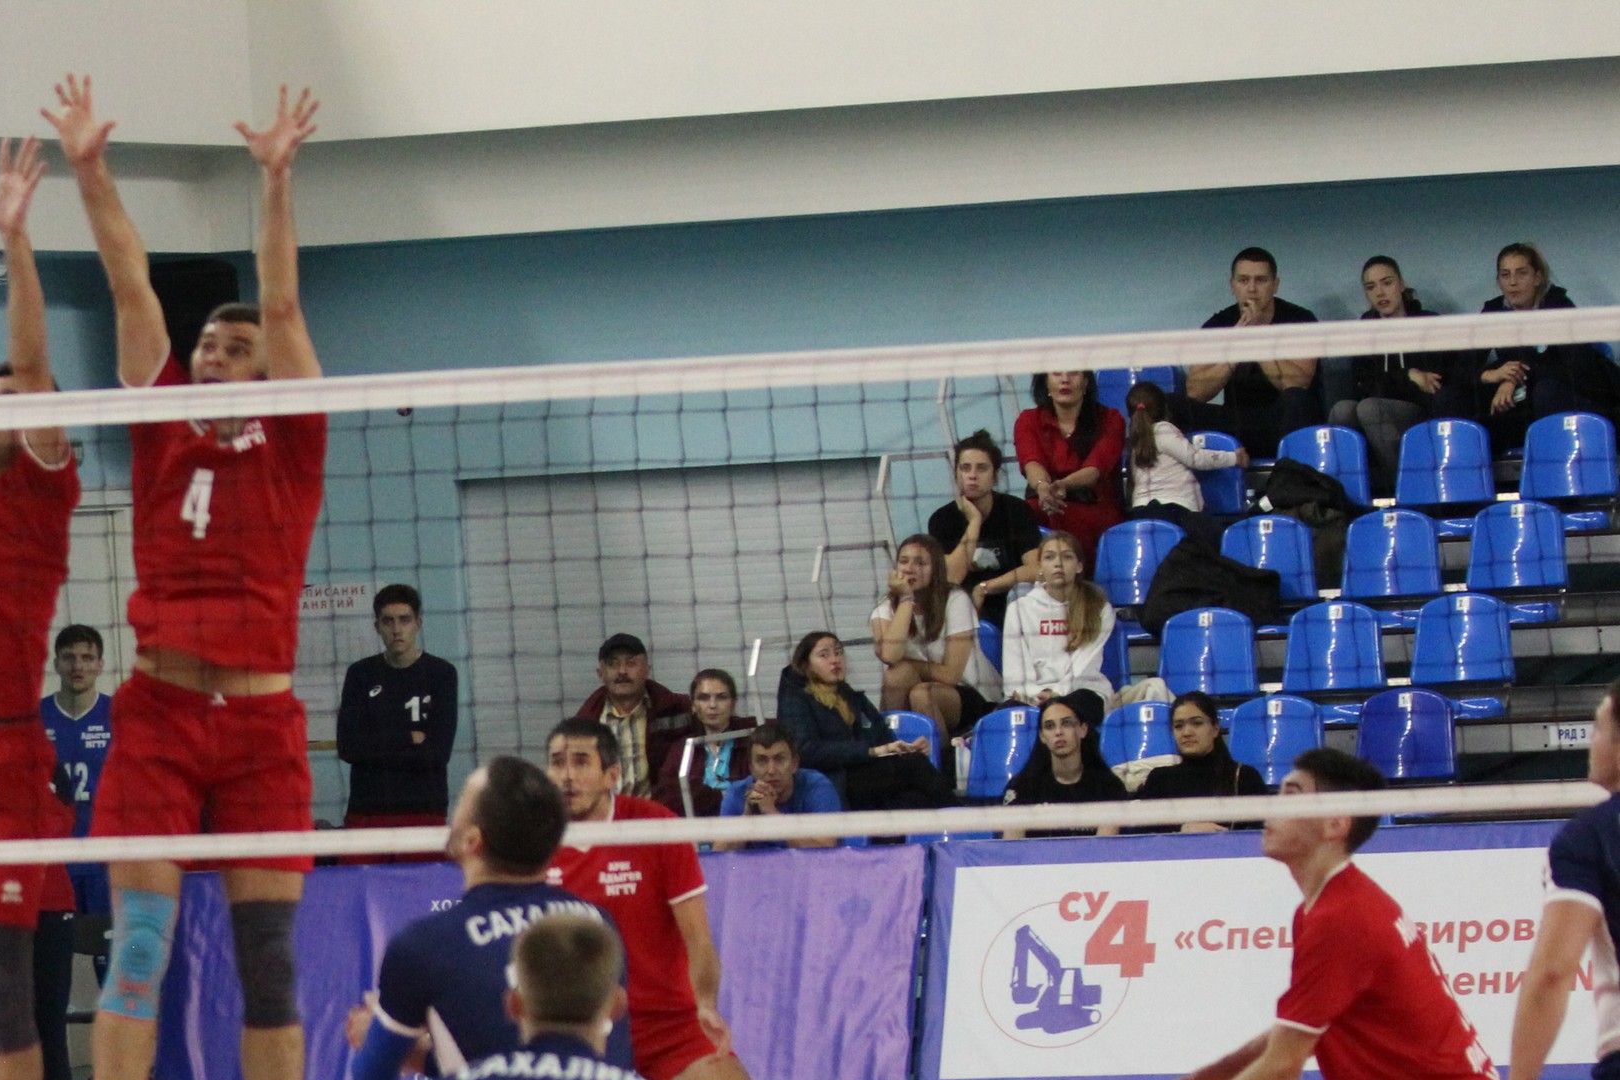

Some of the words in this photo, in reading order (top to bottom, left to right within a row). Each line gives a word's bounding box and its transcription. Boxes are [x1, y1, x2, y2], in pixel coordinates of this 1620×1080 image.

[181, 467, 214, 539] 4
[299, 585, 366, 598] ПИСАНИЕ
[301, 597, 355, 610] АНЯТИЙ
[1558, 728, 1578, 740] РЯД
[1580, 728, 1587, 739] 3
[1058, 891, 1110, 922] СУ
[1084, 900, 1156, 978] 4
